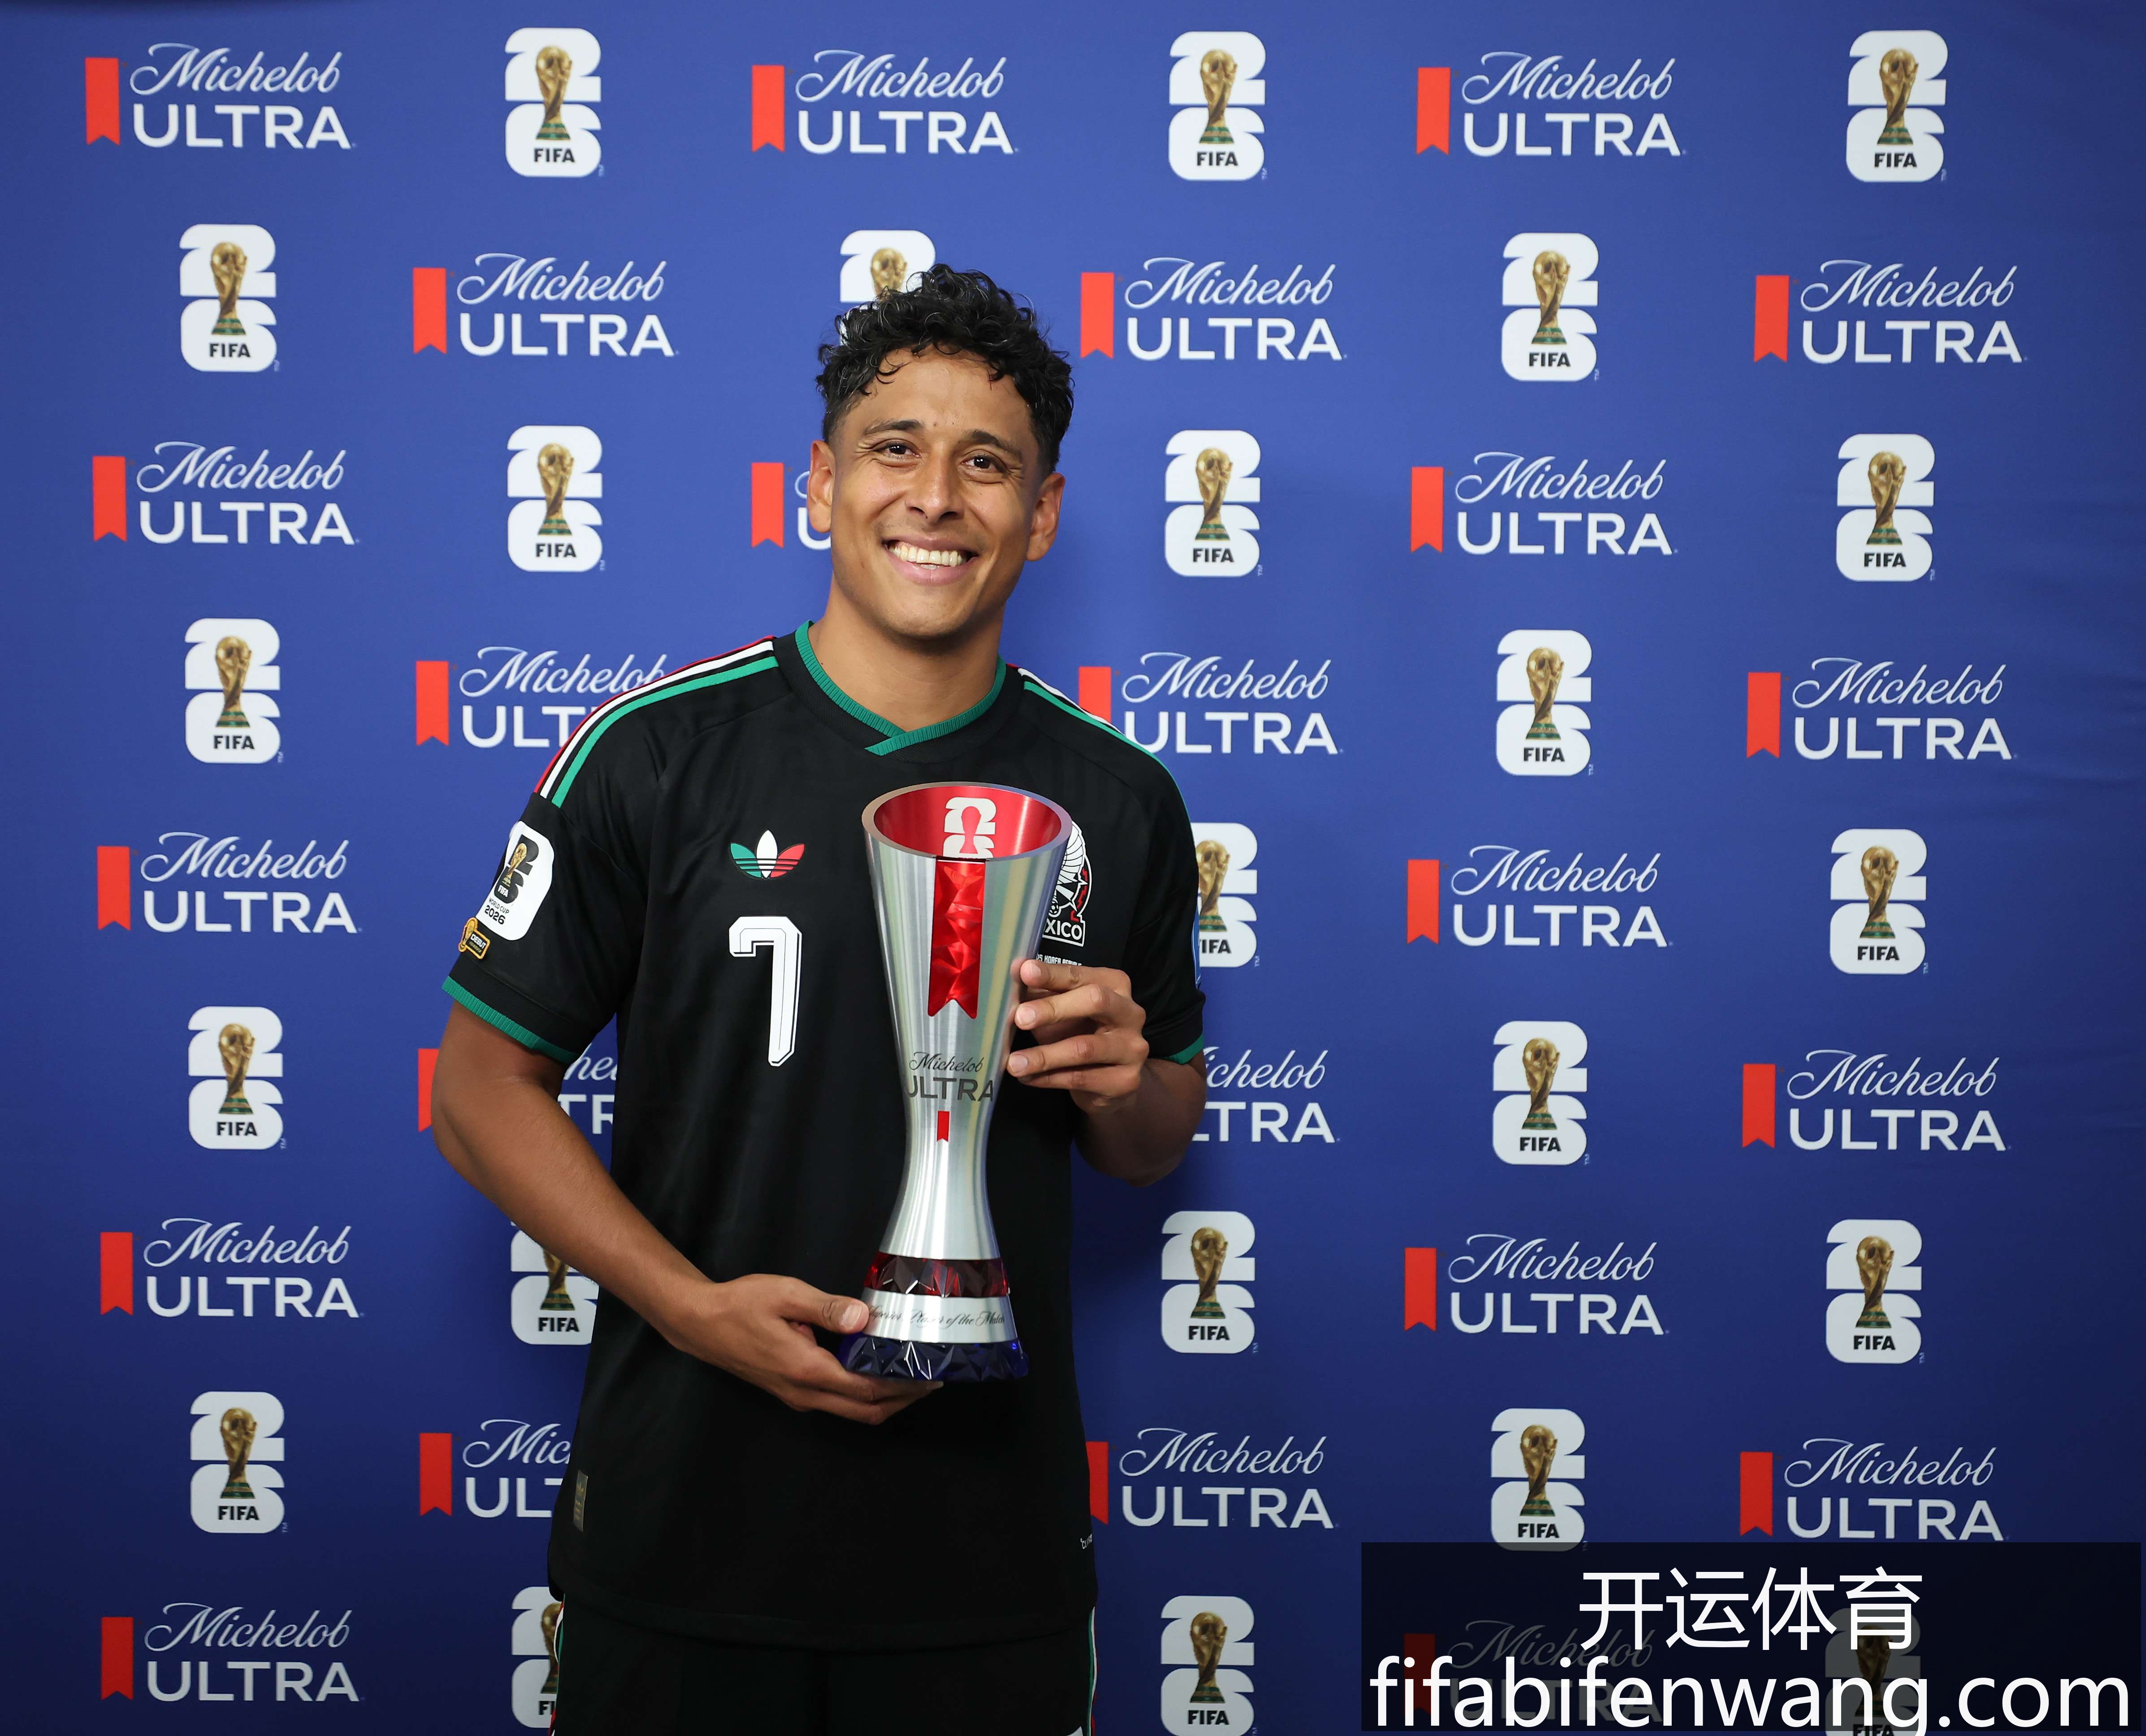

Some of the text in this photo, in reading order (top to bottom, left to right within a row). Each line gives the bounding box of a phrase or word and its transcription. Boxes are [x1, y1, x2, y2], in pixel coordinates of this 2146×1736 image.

[130, 43, 342, 95] Michelob
[795, 50, 1006, 102] Michelob
[1461, 51, 1675, 104] Michelob
[133, 103, 351, 149] ULTRA
[798, 110, 1014, 155] ULTRA
[1464, 113, 1681, 157] ULTRA
[534, 148, 575, 163] FIFA
[1197, 152, 1238, 166] FIFA
[1874, 152, 1917, 168] FIFA
[456, 253, 667, 304] Michelob
[1124, 257, 1335, 309] Michelob
[1800, 259, 2017, 312] Michelob
[209, 343, 251, 358] FIFA
[460, 312, 675, 357] ULTRA
[1127, 317, 1342, 361] ULTRA
[1802, 320, 2022, 365] ULTRA
[1528, 352, 1571, 367] FIFA
[136, 441, 347, 493] Michelob
[1455, 451, 1666, 503] Michelob
[139, 500, 355, 545] ULTRA
[1457, 511, 1673, 556] ULTRA
[536, 543, 577, 558] FIFA
[1192, 548, 1235, 563] FIFA
[1864, 552, 1907, 568] FIFA
[1121, 652, 1331, 703] Michelob
[1792, 657, 2006, 709] Michelob
[213, 735, 255, 750] FIFA
[462, 705, 600, 748] ULT
[1124, 711, 1338, 755] ULTRA
[1795, 716, 2012, 760] ULTRA
[1523, 747, 1565, 762] FIFA
[140, 832, 349, 882] Michelob
[1451, 845, 1661, 896] Michelob
[143, 890, 358, 933] ULTRA
[489, 897, 510, 915] WORLD CUP
[497, 884, 509, 897] FIFA
[484, 905, 506, 925] 2026
[1044, 918, 1083, 941] XICO
[1453, 903, 1667, 947] ULTRA
[470, 933, 487, 949] DEBUT
[1199, 939, 1232, 954] IFA
[1857, 945, 1900, 961] FIFA
[728, 916, 802, 1067] 7
[909, 1051, 984, 1072] Michelob
[1203, 1046, 1328, 1089] chelob
[1787, 1049, 2000, 1100] Michelob
[905, 1075, 994, 1102] ULTRA
[217, 1121, 258, 1137] FIFA
[1191, 1101, 1335, 1143] TRA
[1789, 1108, 2007, 1151] ULTRA
[1519, 1136, 1562, 1152] FIFA
[143, 1218, 351, 1267] Michelob
[1448, 1234, 1657, 1283] Michelob
[147, 1276, 359, 1318] ULTRA
[1451, 1292, 1664, 1335] ULTRA
[538, 1317, 580, 1332] FIFA
[1188, 1325, 1231, 1341] FIFA
[1853, 1335, 1896, 1351] FIFA
[1119, 1428, 1327, 1476] Michelob
[1784, 1438, 1997, 1488] Michelob
[217, 1505, 260, 1521] FIFA
[1122, 1485, 1334, 1529] ULTRA
[1787, 1496, 2004, 1541] ULTRA
[1517, 1522, 1561, 1539] FIFA
[144, 1602, 352, 1652] Michelob
[147, 1661, 360, 1702] ULTRA
[539, 1701, 557, 1715] FI
[1187, 1709, 1231, 1726] FIFA
